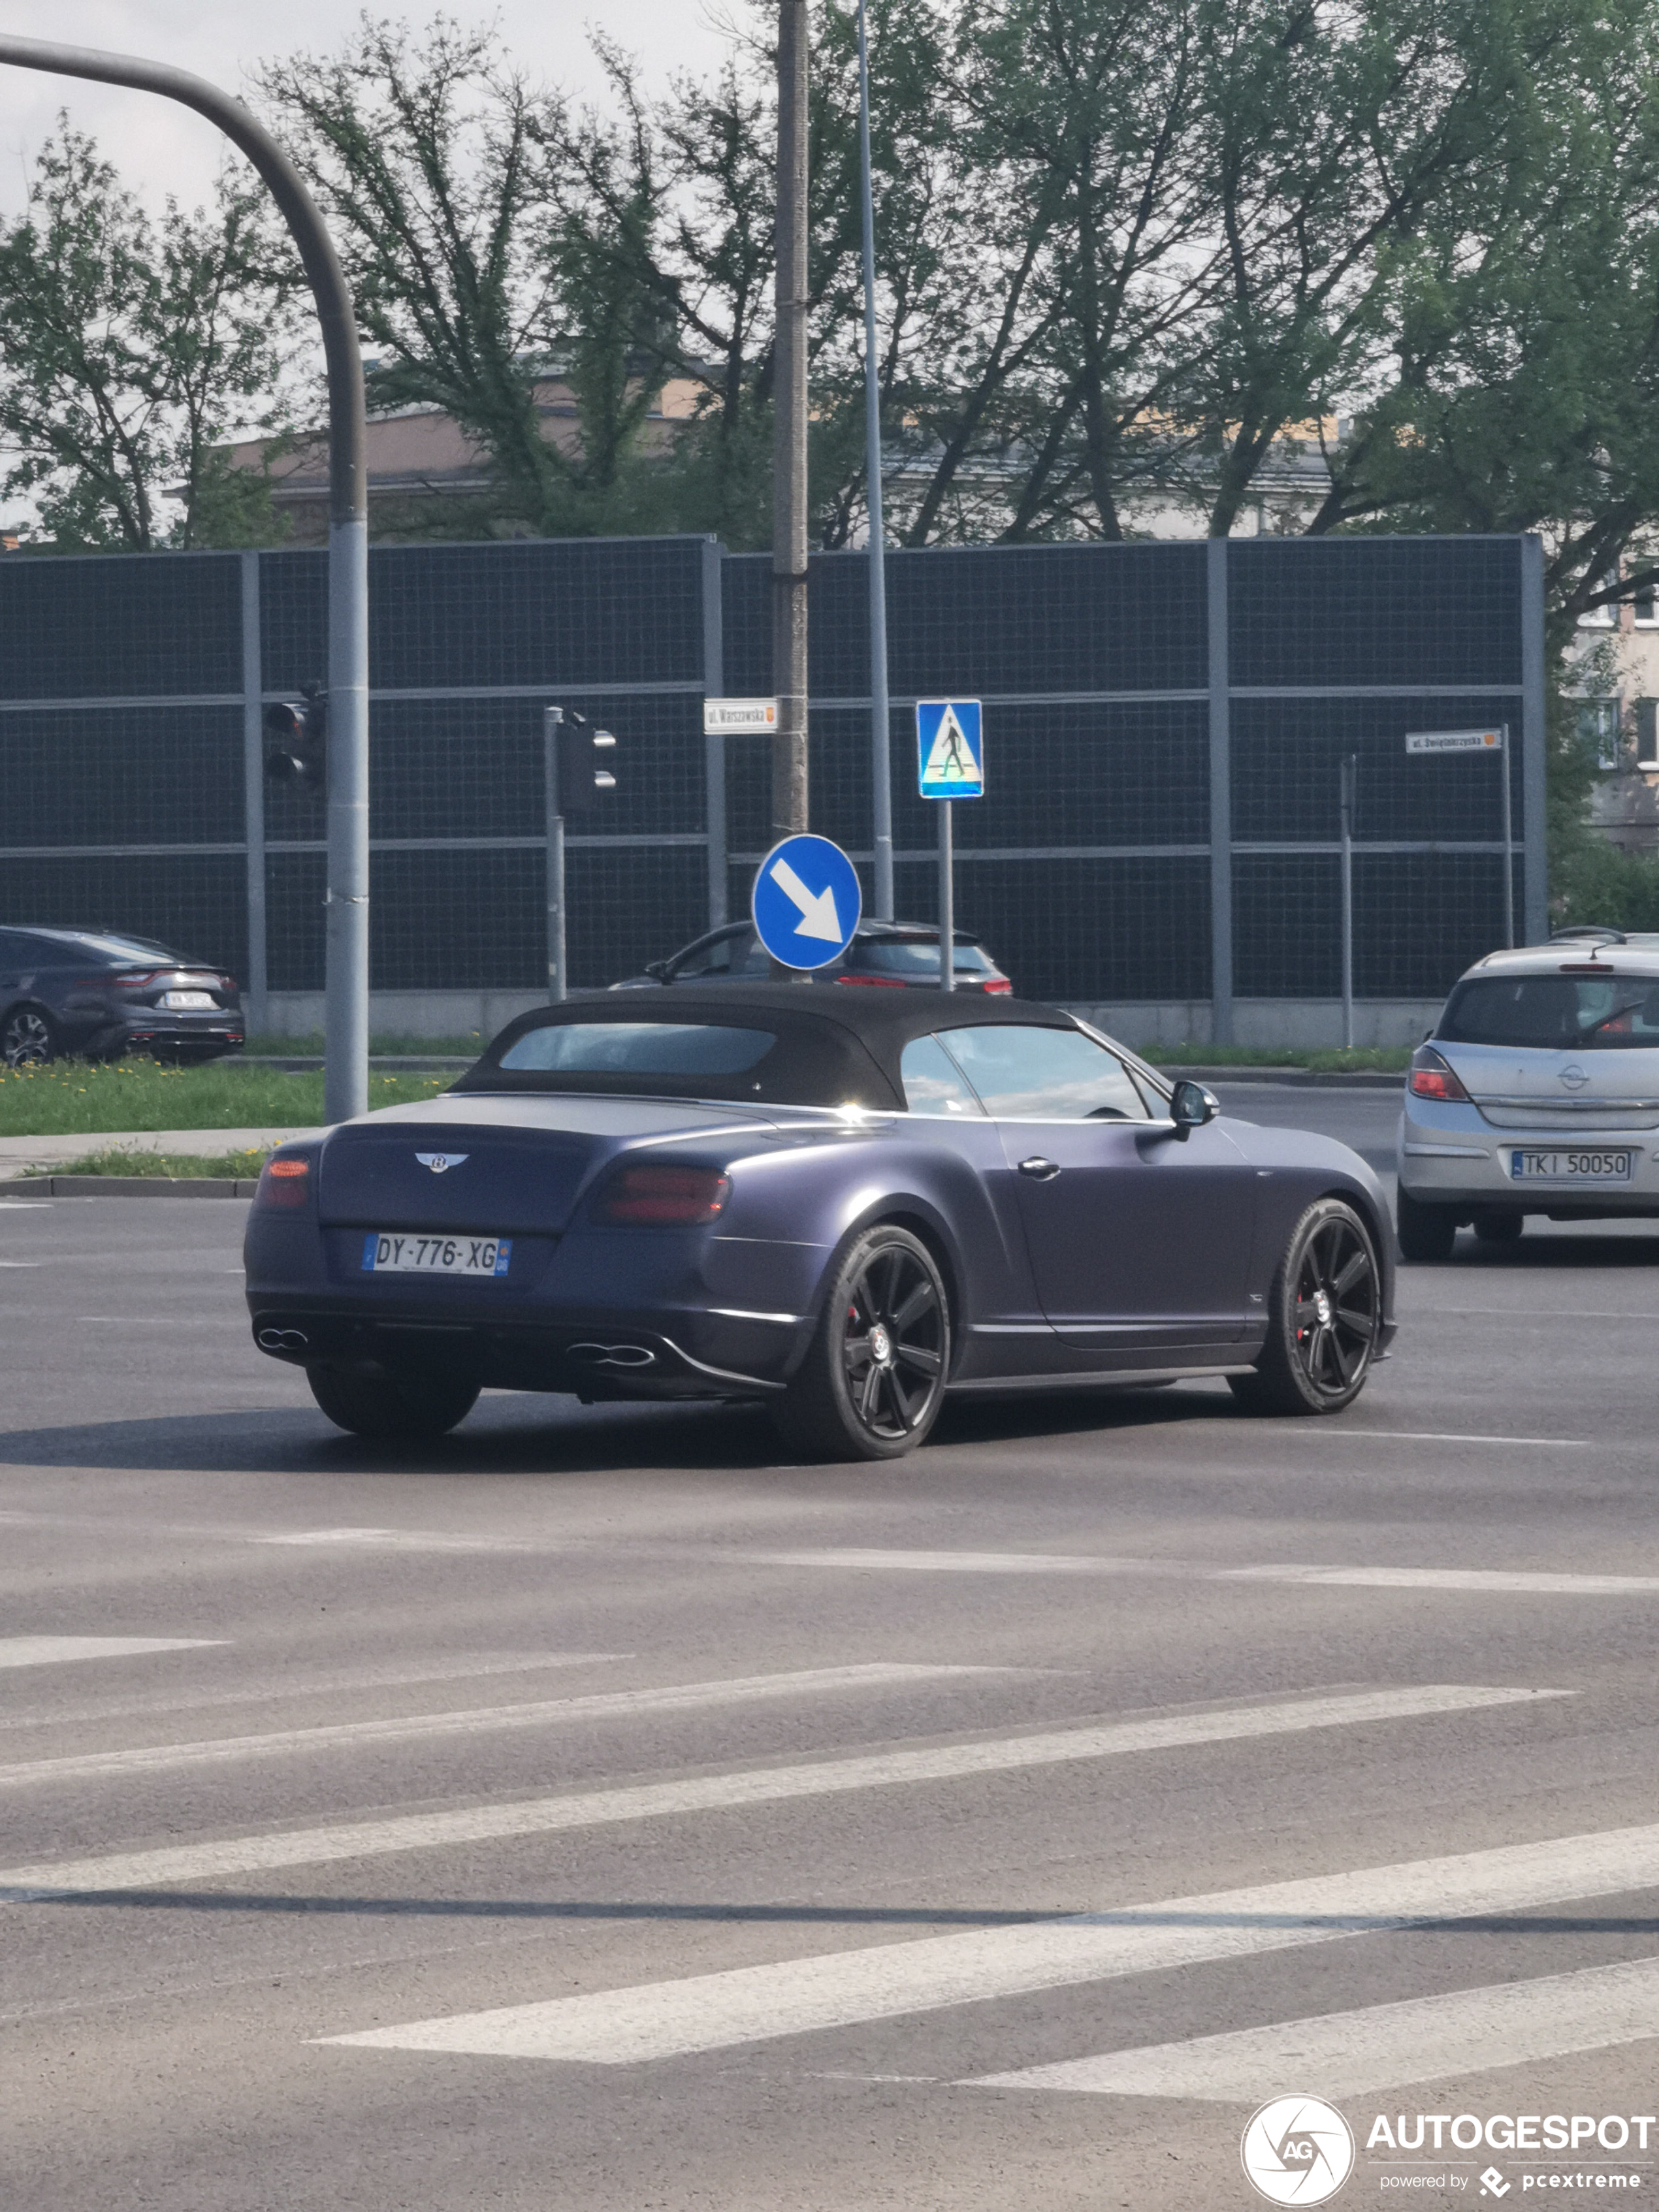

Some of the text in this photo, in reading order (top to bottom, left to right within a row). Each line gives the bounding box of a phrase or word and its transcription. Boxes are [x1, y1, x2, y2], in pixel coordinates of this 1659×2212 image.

[709, 708, 764, 724] ul. Warszawska
[1523, 1155, 1626, 1174] TKI 50050
[376, 1238, 496, 1269] DY-776-XG
